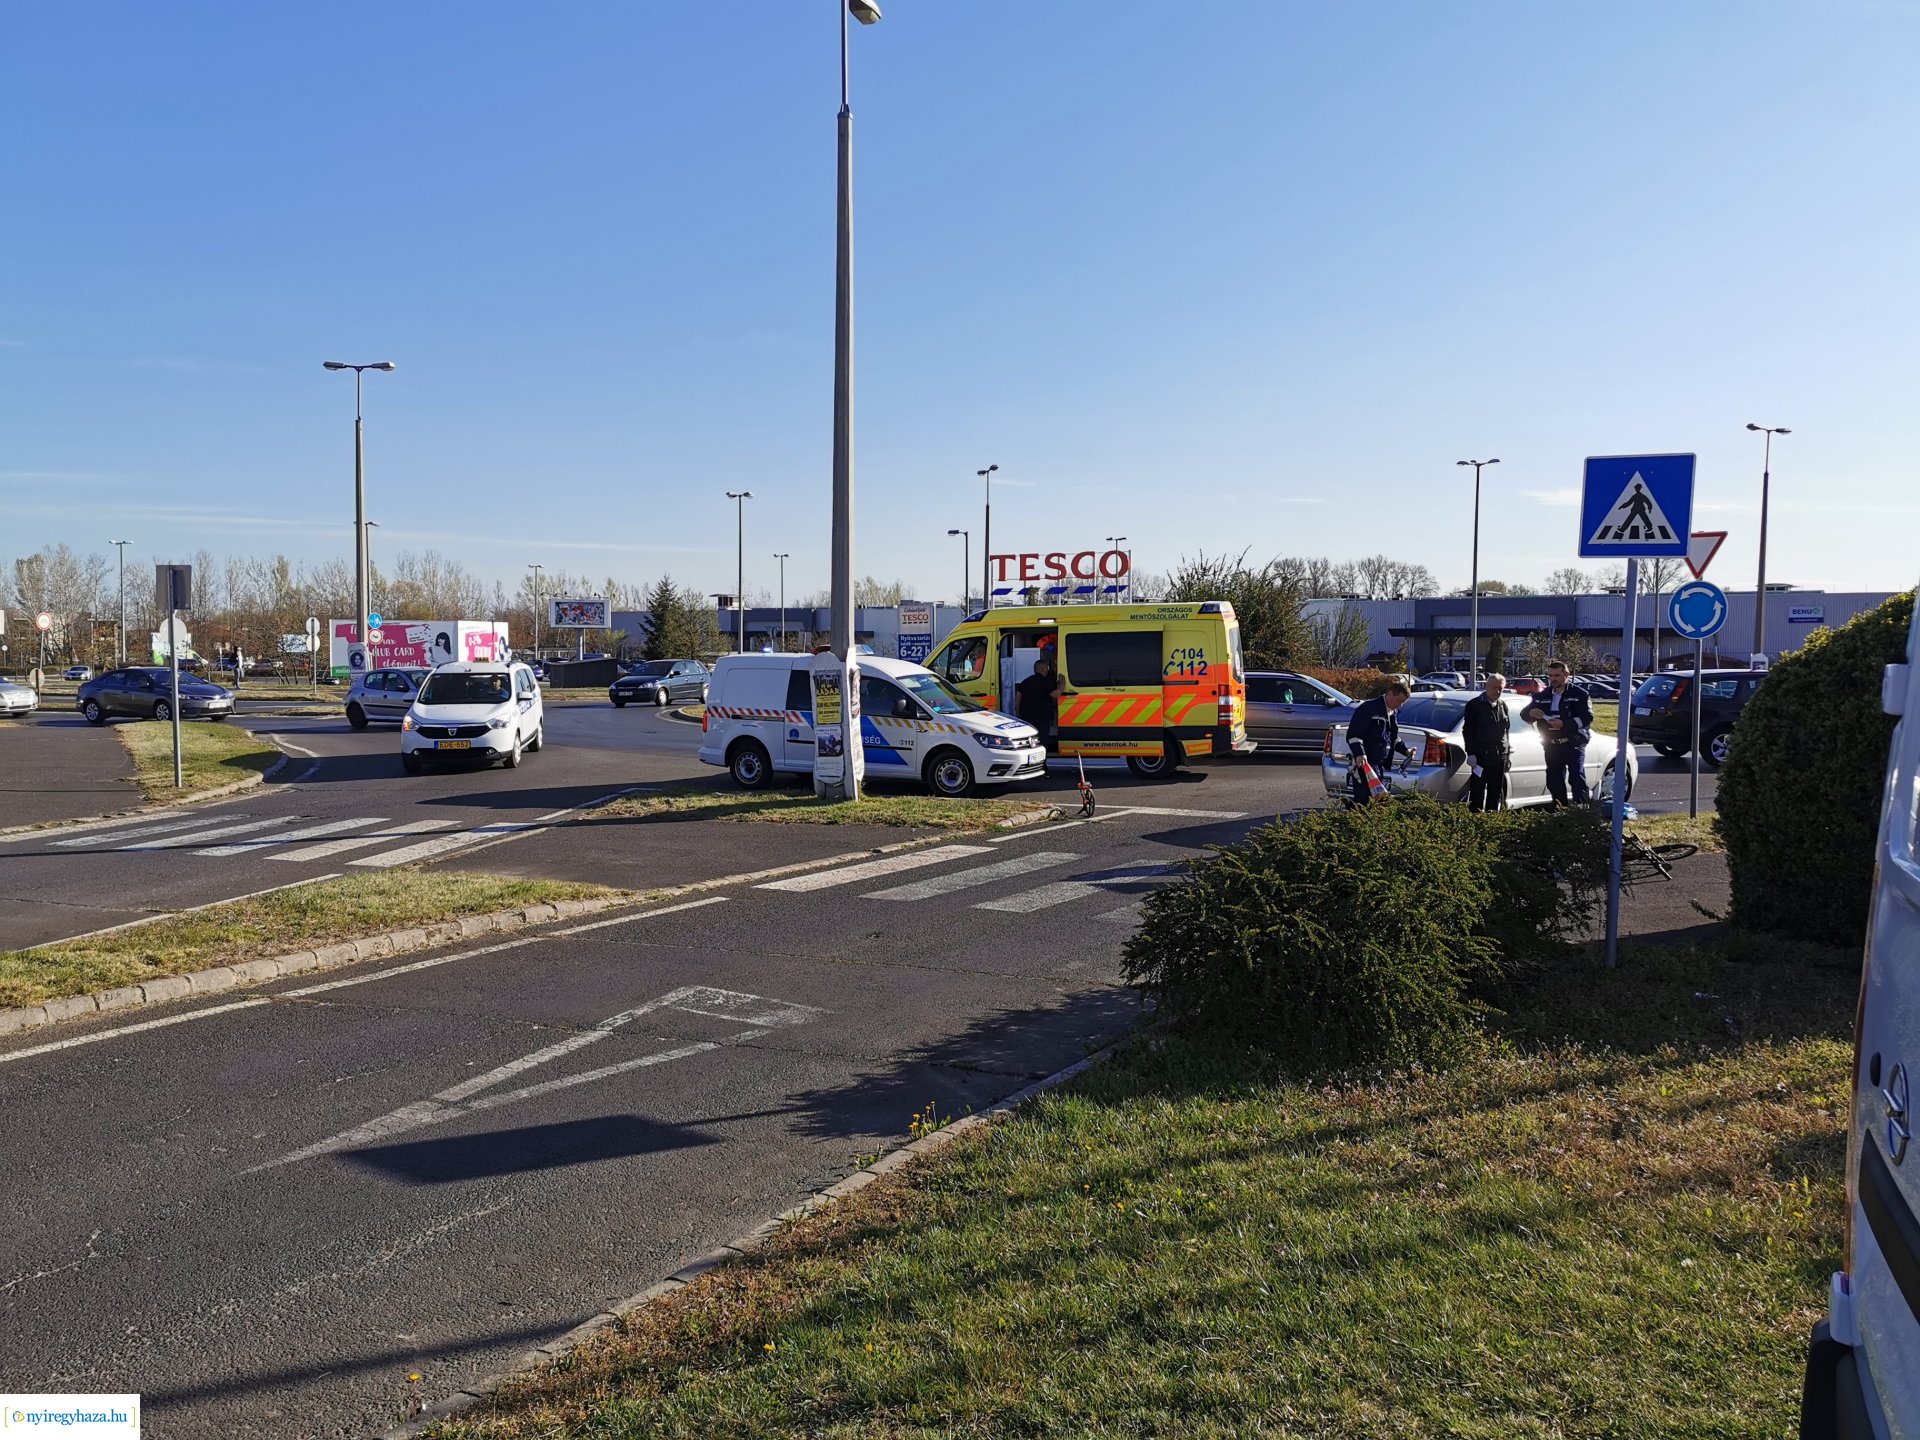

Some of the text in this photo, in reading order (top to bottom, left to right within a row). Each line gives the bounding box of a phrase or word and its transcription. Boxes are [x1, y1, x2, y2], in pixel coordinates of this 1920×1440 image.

[990, 550, 1130, 582] TESCO
[902, 613, 929, 621] TESCO
[394, 646, 415, 656] CARD
[900, 646, 923, 657] 6-22
[1180, 648, 1204, 659] 104
[1177, 660, 1208, 676] 112
